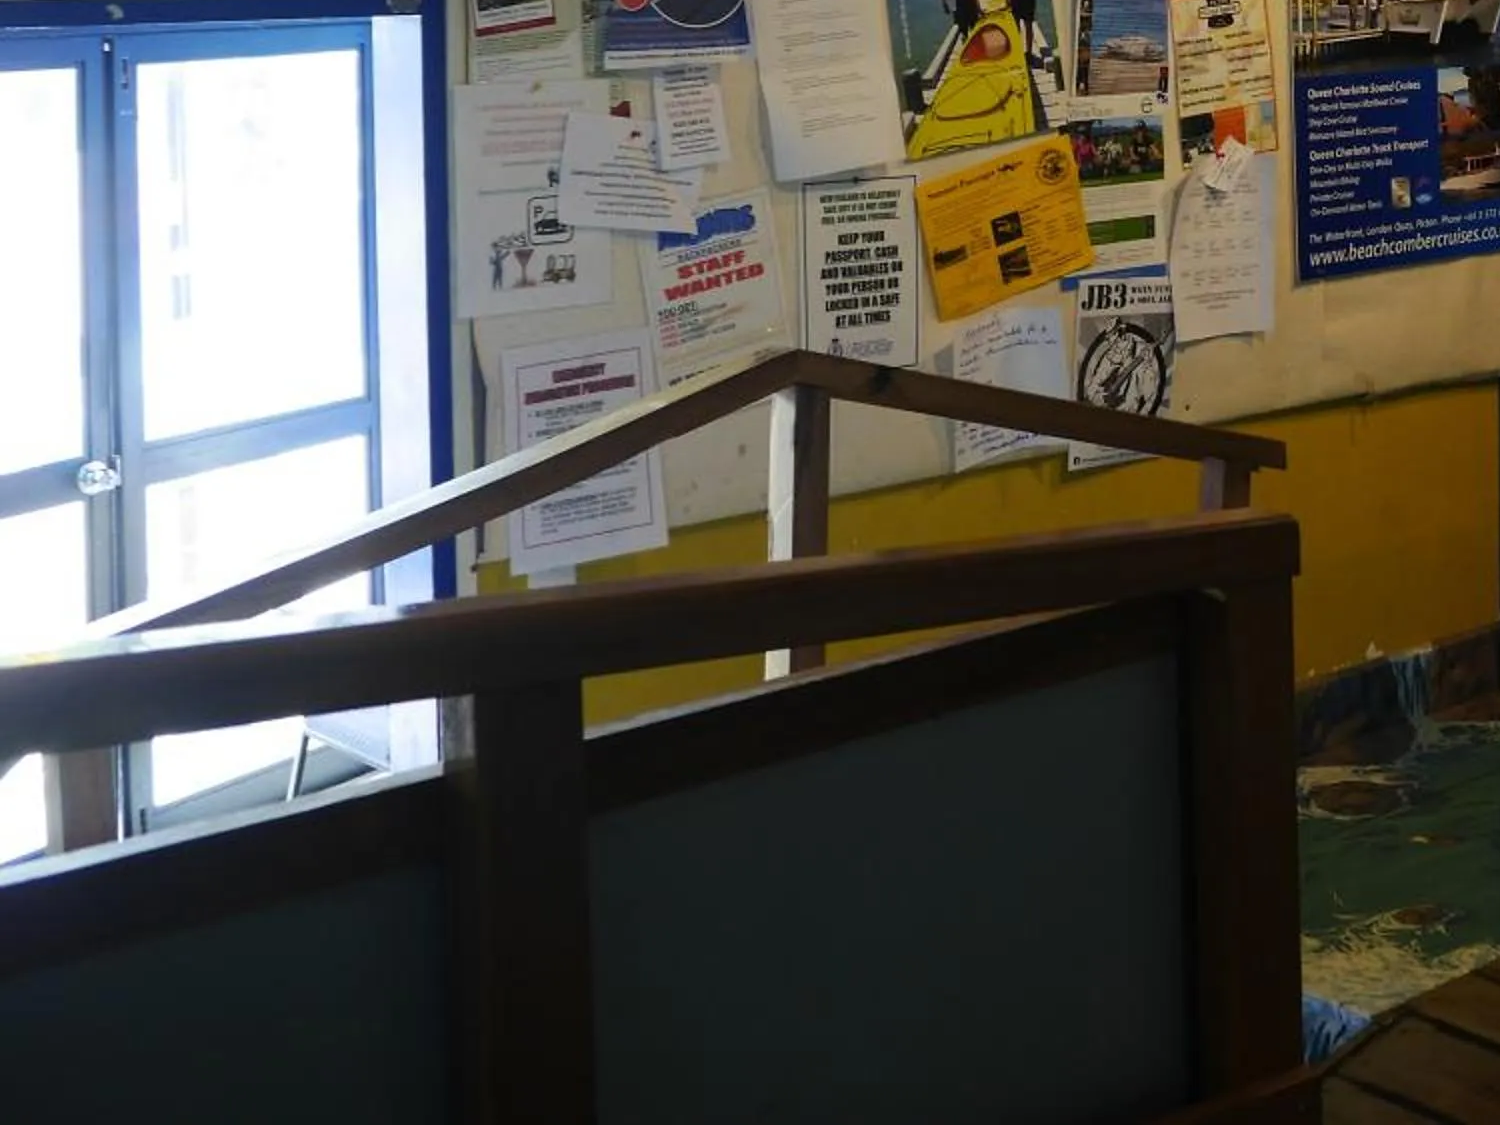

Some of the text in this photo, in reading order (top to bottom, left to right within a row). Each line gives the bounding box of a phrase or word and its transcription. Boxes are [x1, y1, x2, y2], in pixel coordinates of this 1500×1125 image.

[837, 231, 885, 245] KEEP YOUR
[874, 245, 899, 257] CASH
[677, 250, 746, 279] STAFF
[821, 267, 839, 279] AND
[840, 262, 889, 278] VALUABLES
[663, 263, 765, 301] WANTED
[825, 282, 850, 295] YOUR
[851, 279, 885, 294] PERSON
[825, 293, 900, 312] LOCKED IN A SAFE
[1081, 283, 1127, 311] JB3
[836, 310, 891, 328] AT ALL TIMES
